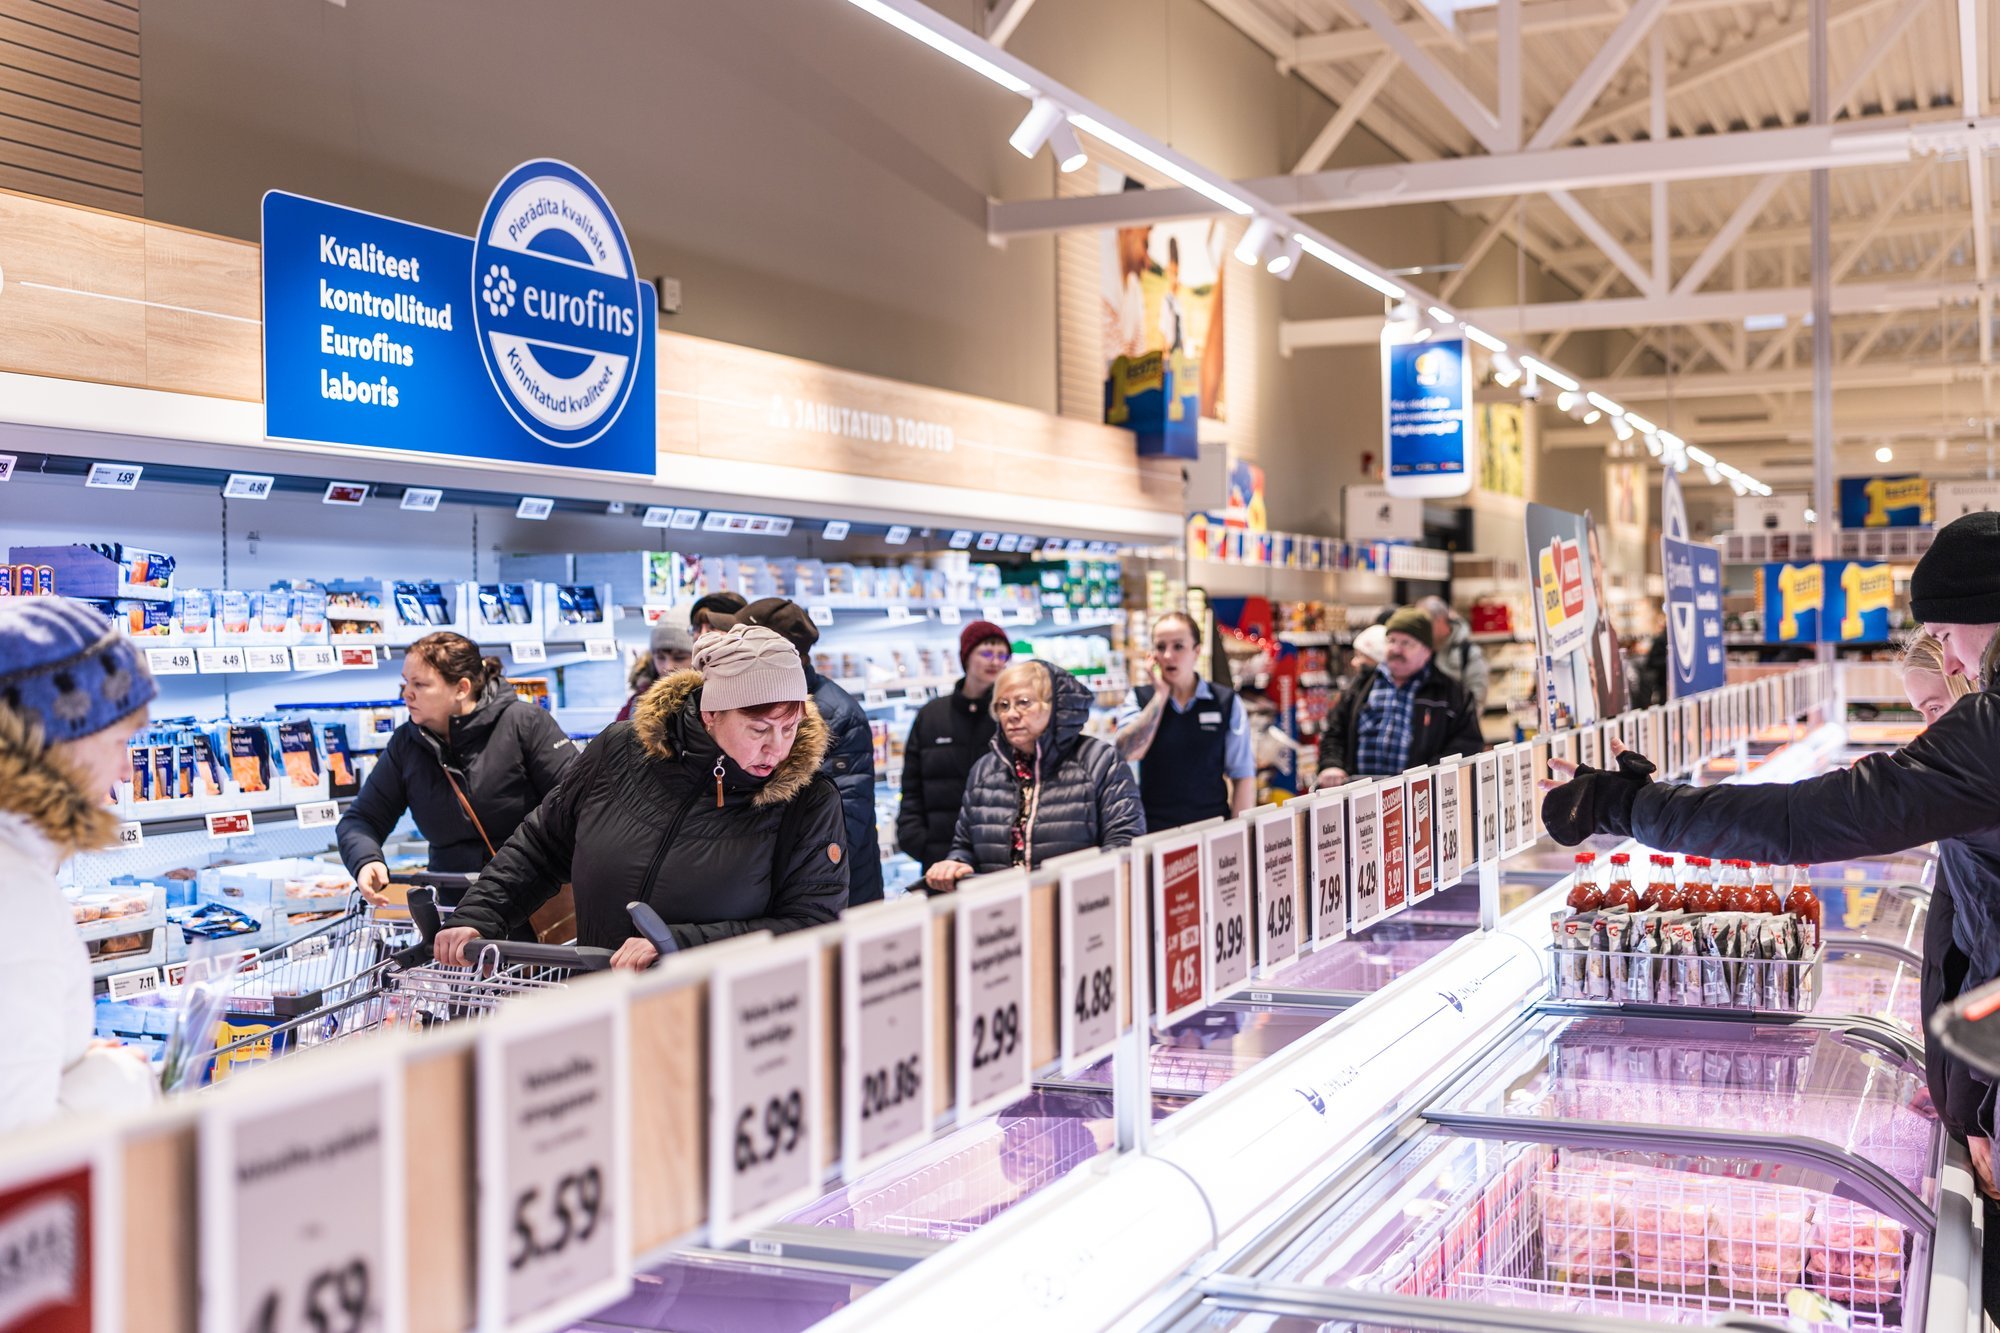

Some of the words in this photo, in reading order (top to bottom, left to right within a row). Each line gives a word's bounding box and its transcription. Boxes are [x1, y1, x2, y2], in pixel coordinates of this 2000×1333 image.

[320, 235, 420, 282] Kvaliteet
[320, 279, 452, 331] kontrollitud
[524, 284, 635, 337] eurofins
[321, 325, 414, 367] Eurofins
[321, 369, 399, 408] laboris
[507, 347, 567, 413] Kinnitatud
[569, 364, 614, 414] kvaliteet
[795, 399, 893, 443] JAHUTATUD
[896, 416, 955, 453] TOOTED
[116, 471, 135, 483] 1.59
[249, 481, 267, 493] 0.98
[172, 655, 190, 667] 4.99
[222, 655, 239, 666] 4.49
[320, 809, 334, 820] 1.99
[120, 829, 137, 844] 4.25
[1443, 828, 1457, 862] 3.89
[1320, 873, 1340, 917] 7.99
[1358, 860, 1376, 899] 4.29
[1388, 868, 1401, 896] 3.99
[1267, 894, 1292, 939] 4.99
[1215, 914, 1243, 965] 9.99
[139, 975, 154, 989] 7.11
[1075, 965, 1113, 1023] 4.88
[1172, 953, 1196, 995] 4.15
[972, 1001, 1018, 1070] 2.99
[734, 1088, 803, 1174] 6.99
[509, 1164, 602, 1272] 5.59
